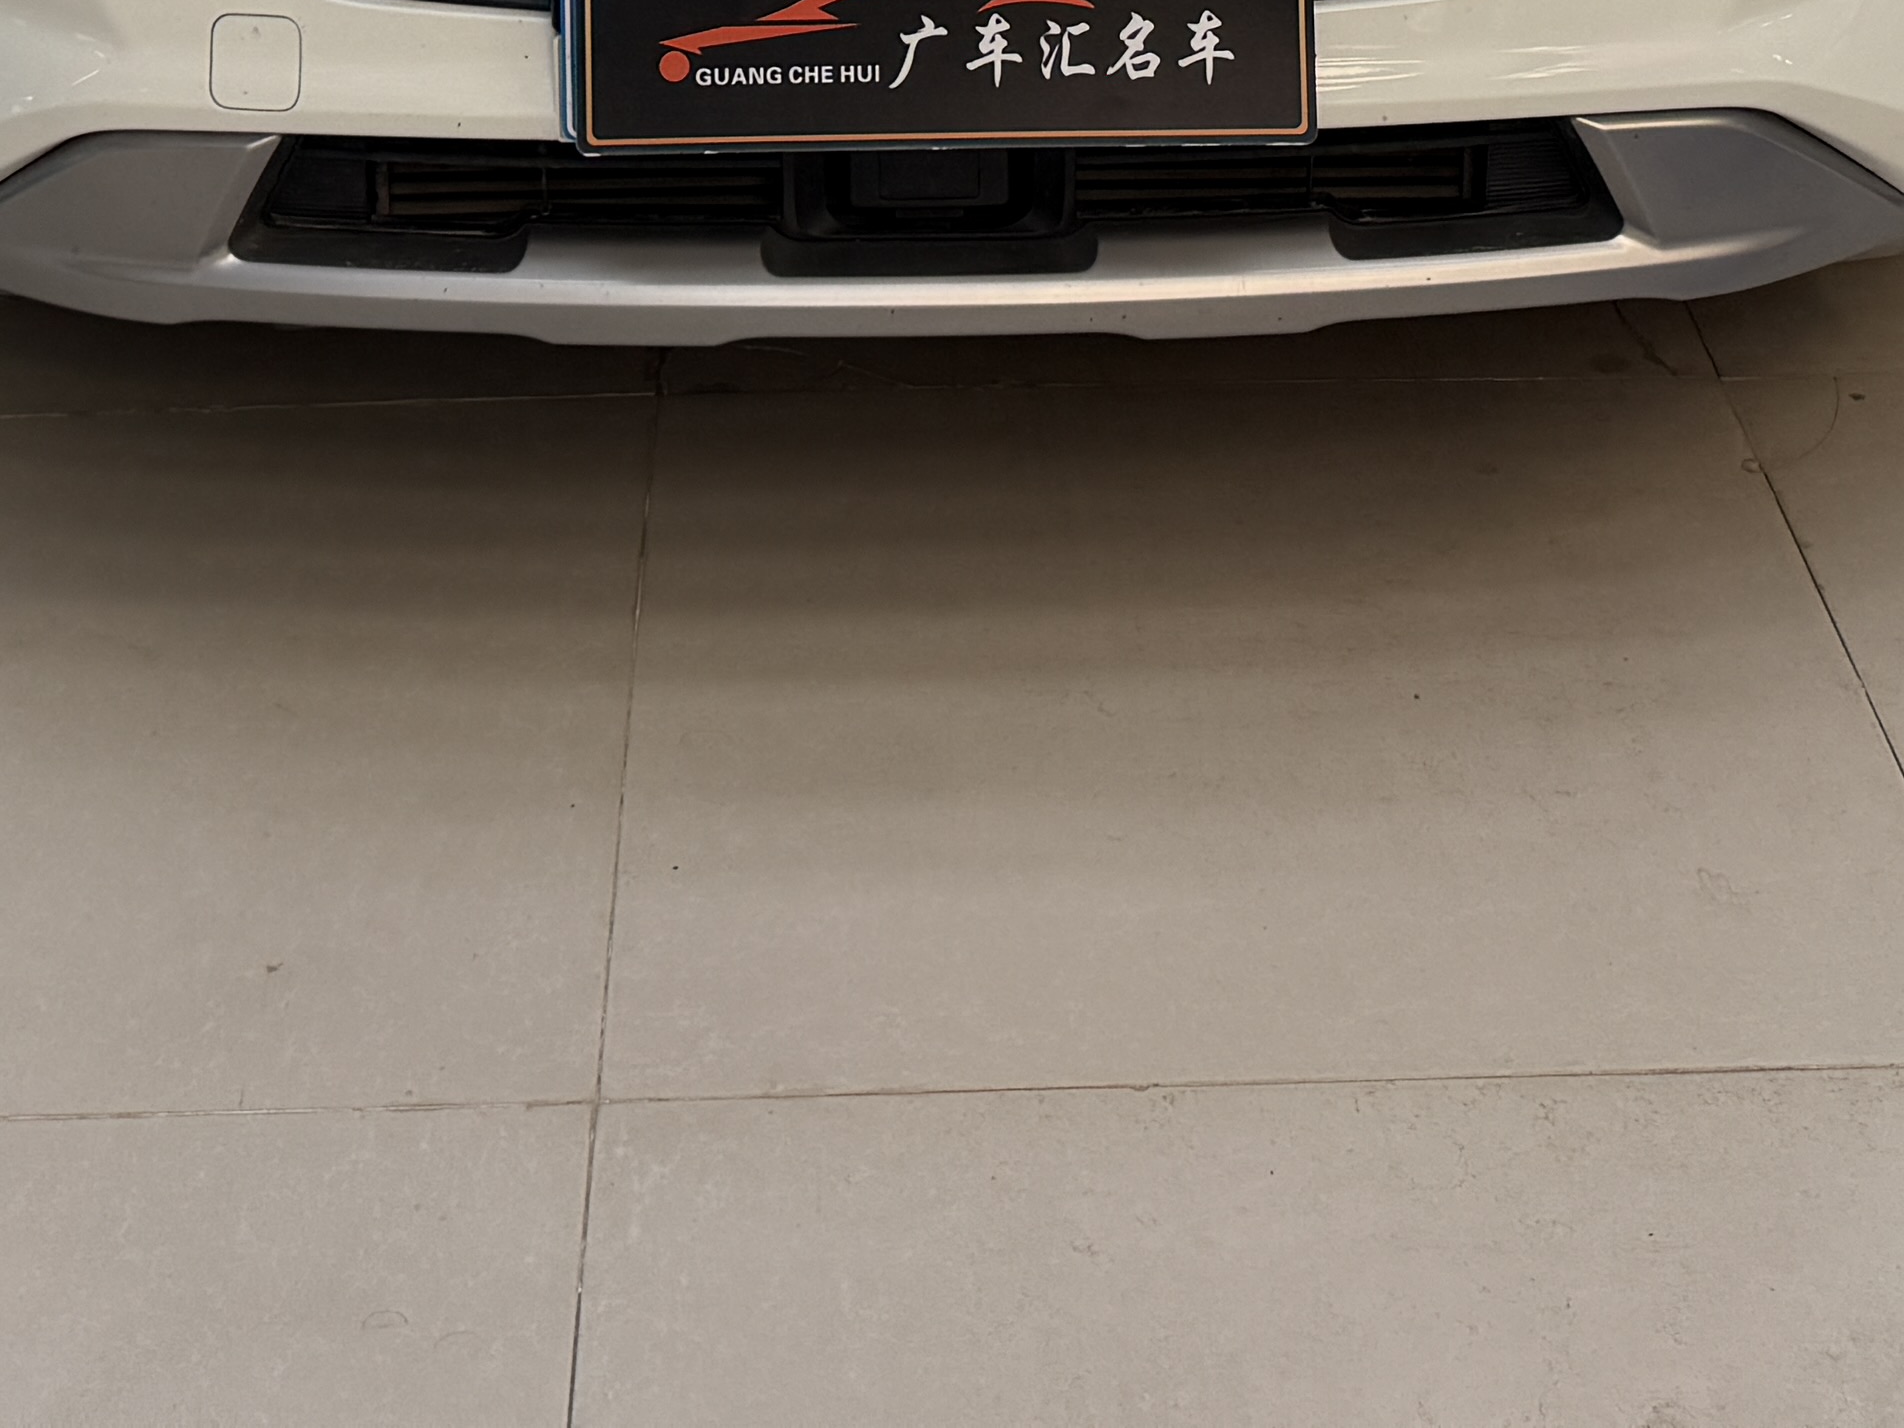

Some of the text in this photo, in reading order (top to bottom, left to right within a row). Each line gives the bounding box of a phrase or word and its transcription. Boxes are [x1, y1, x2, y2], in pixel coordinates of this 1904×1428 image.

[695, 64, 881, 87] GUANG CHE HUI
[888, 9, 1234, 90] 广车汇名车
